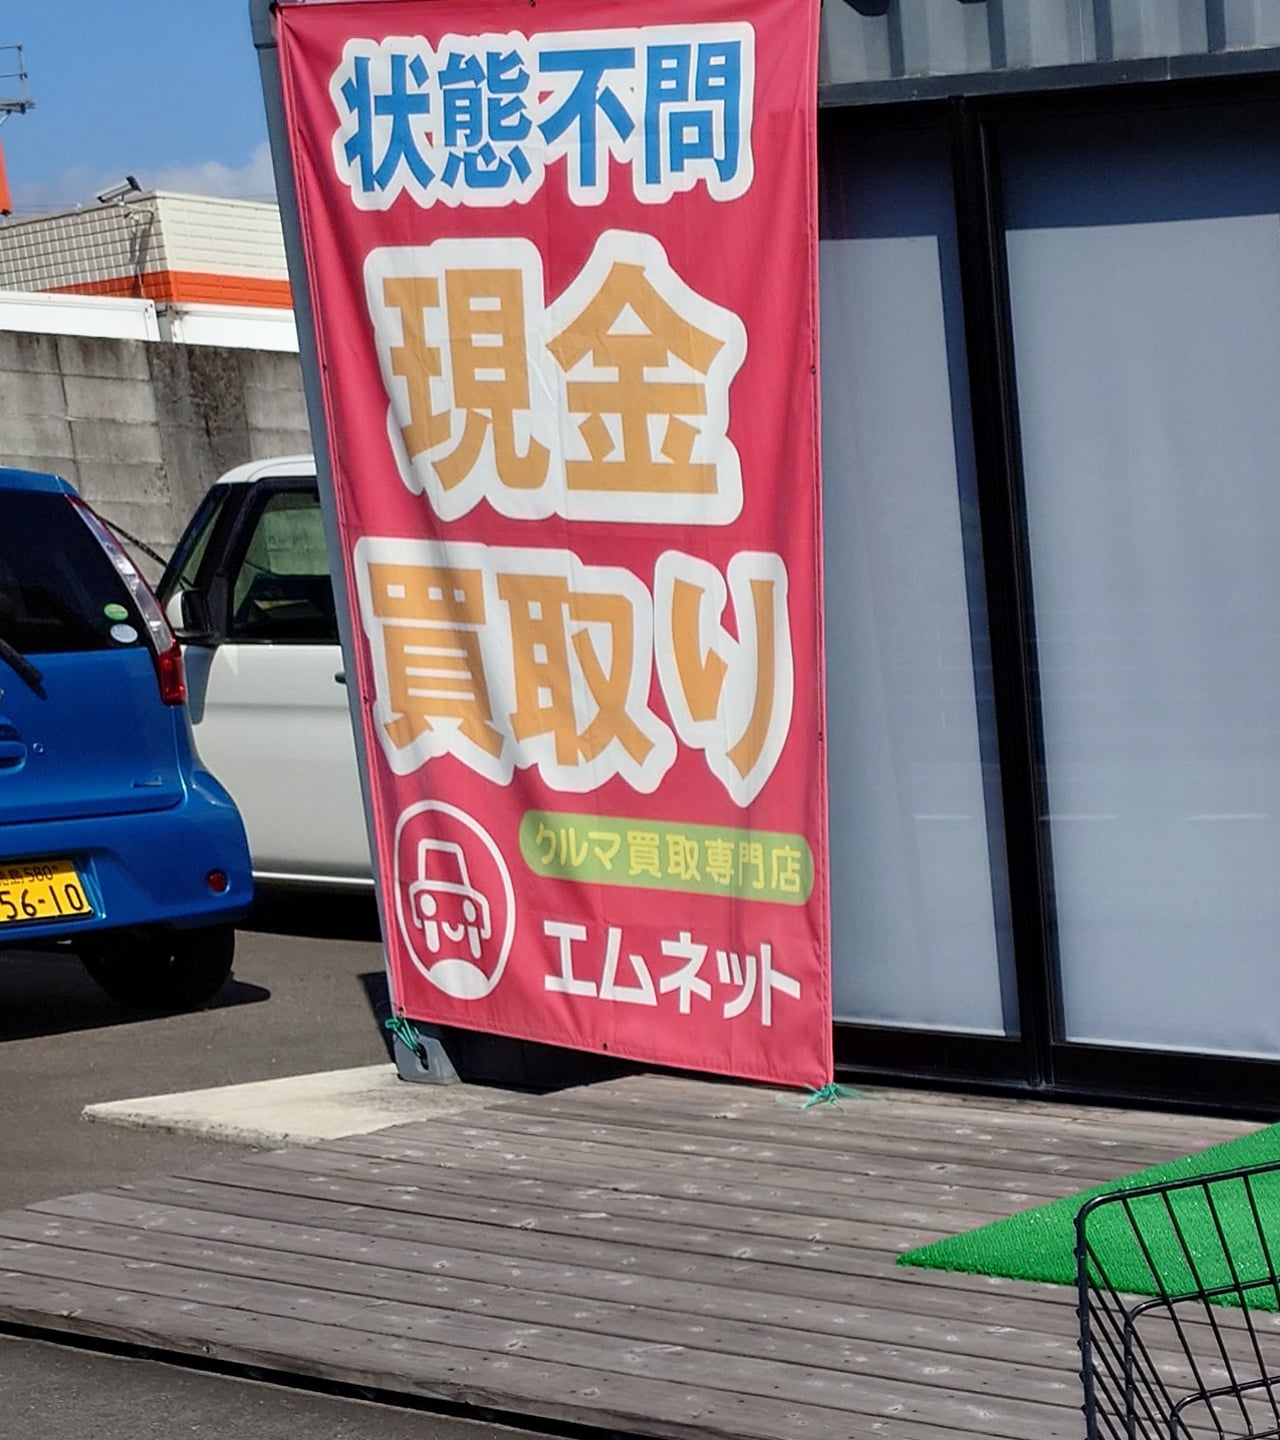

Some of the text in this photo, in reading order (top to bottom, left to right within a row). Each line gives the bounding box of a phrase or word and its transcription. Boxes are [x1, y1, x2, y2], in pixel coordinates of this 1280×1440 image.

[340, 40, 742, 193] 状態不問
[381, 260, 726, 495] 現金
[367, 562, 776, 781] 買取り
[535, 820, 802, 894] クルマ買取専門店
[542, 918, 801, 1026] エムネット
